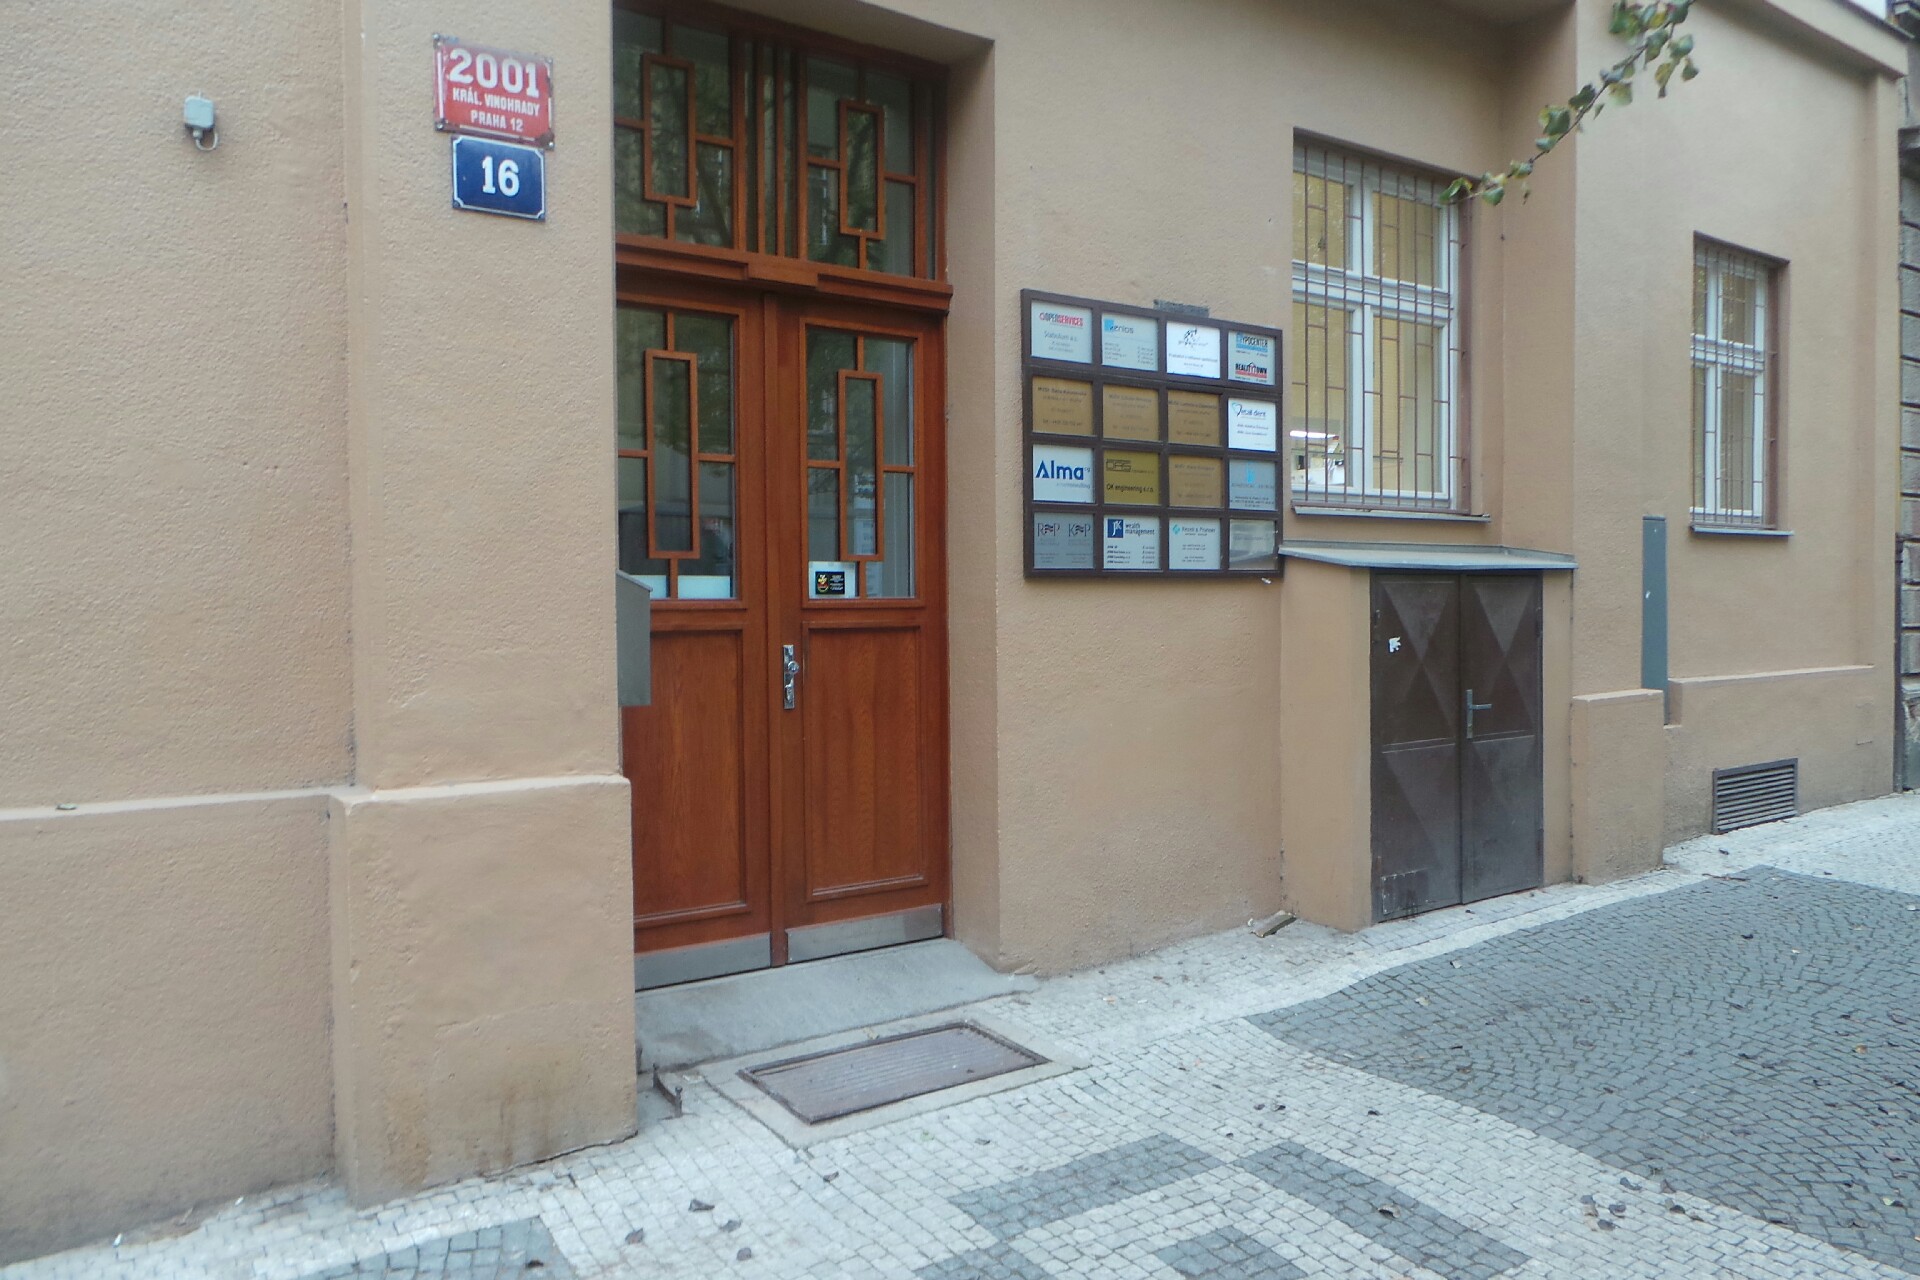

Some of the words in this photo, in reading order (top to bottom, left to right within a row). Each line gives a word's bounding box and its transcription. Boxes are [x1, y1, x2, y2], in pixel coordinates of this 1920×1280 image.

[447, 48, 540, 99] 2001
[452, 87, 483, 106] KRÁL.
[484, 93, 541, 117] VINOHRADY
[470, 109, 508, 130] PRAHA
[510, 117, 524, 132] 12
[482, 156, 520, 197] 16
[1035, 460, 1084, 480] Alma
[1115, 485, 1143, 493] engineering
